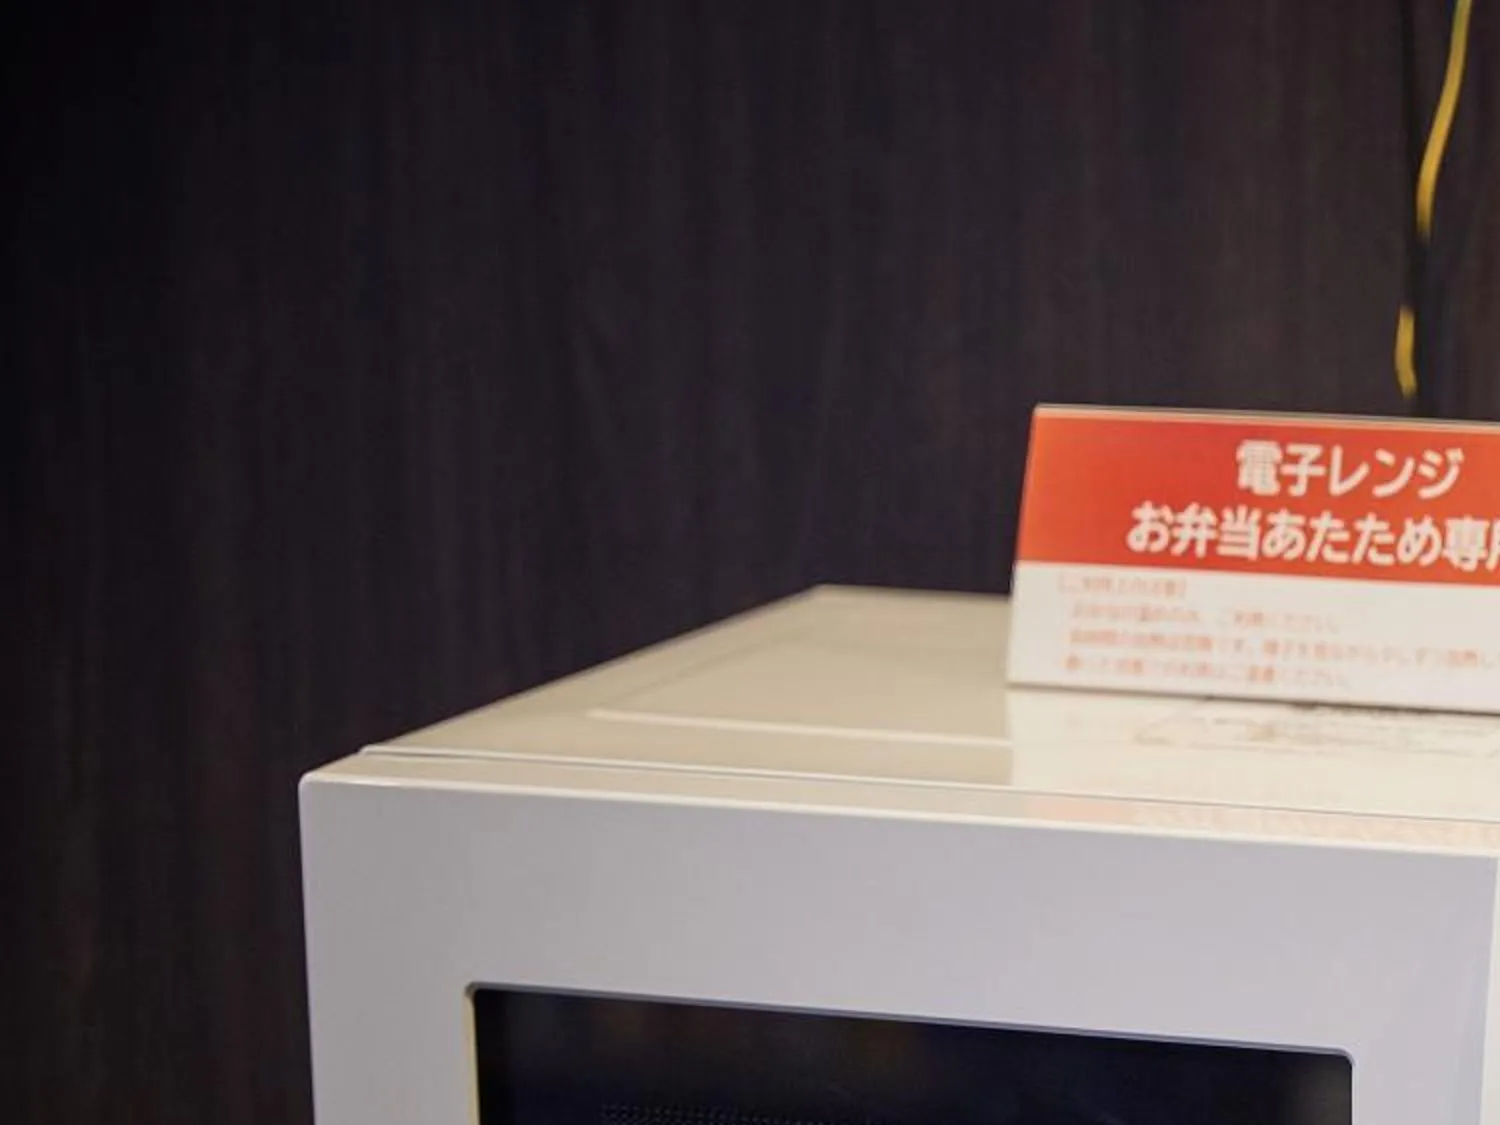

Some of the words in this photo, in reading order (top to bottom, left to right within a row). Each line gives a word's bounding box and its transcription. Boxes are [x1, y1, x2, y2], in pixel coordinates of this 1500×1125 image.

[1235, 440, 1464, 499] 電子レンジ
